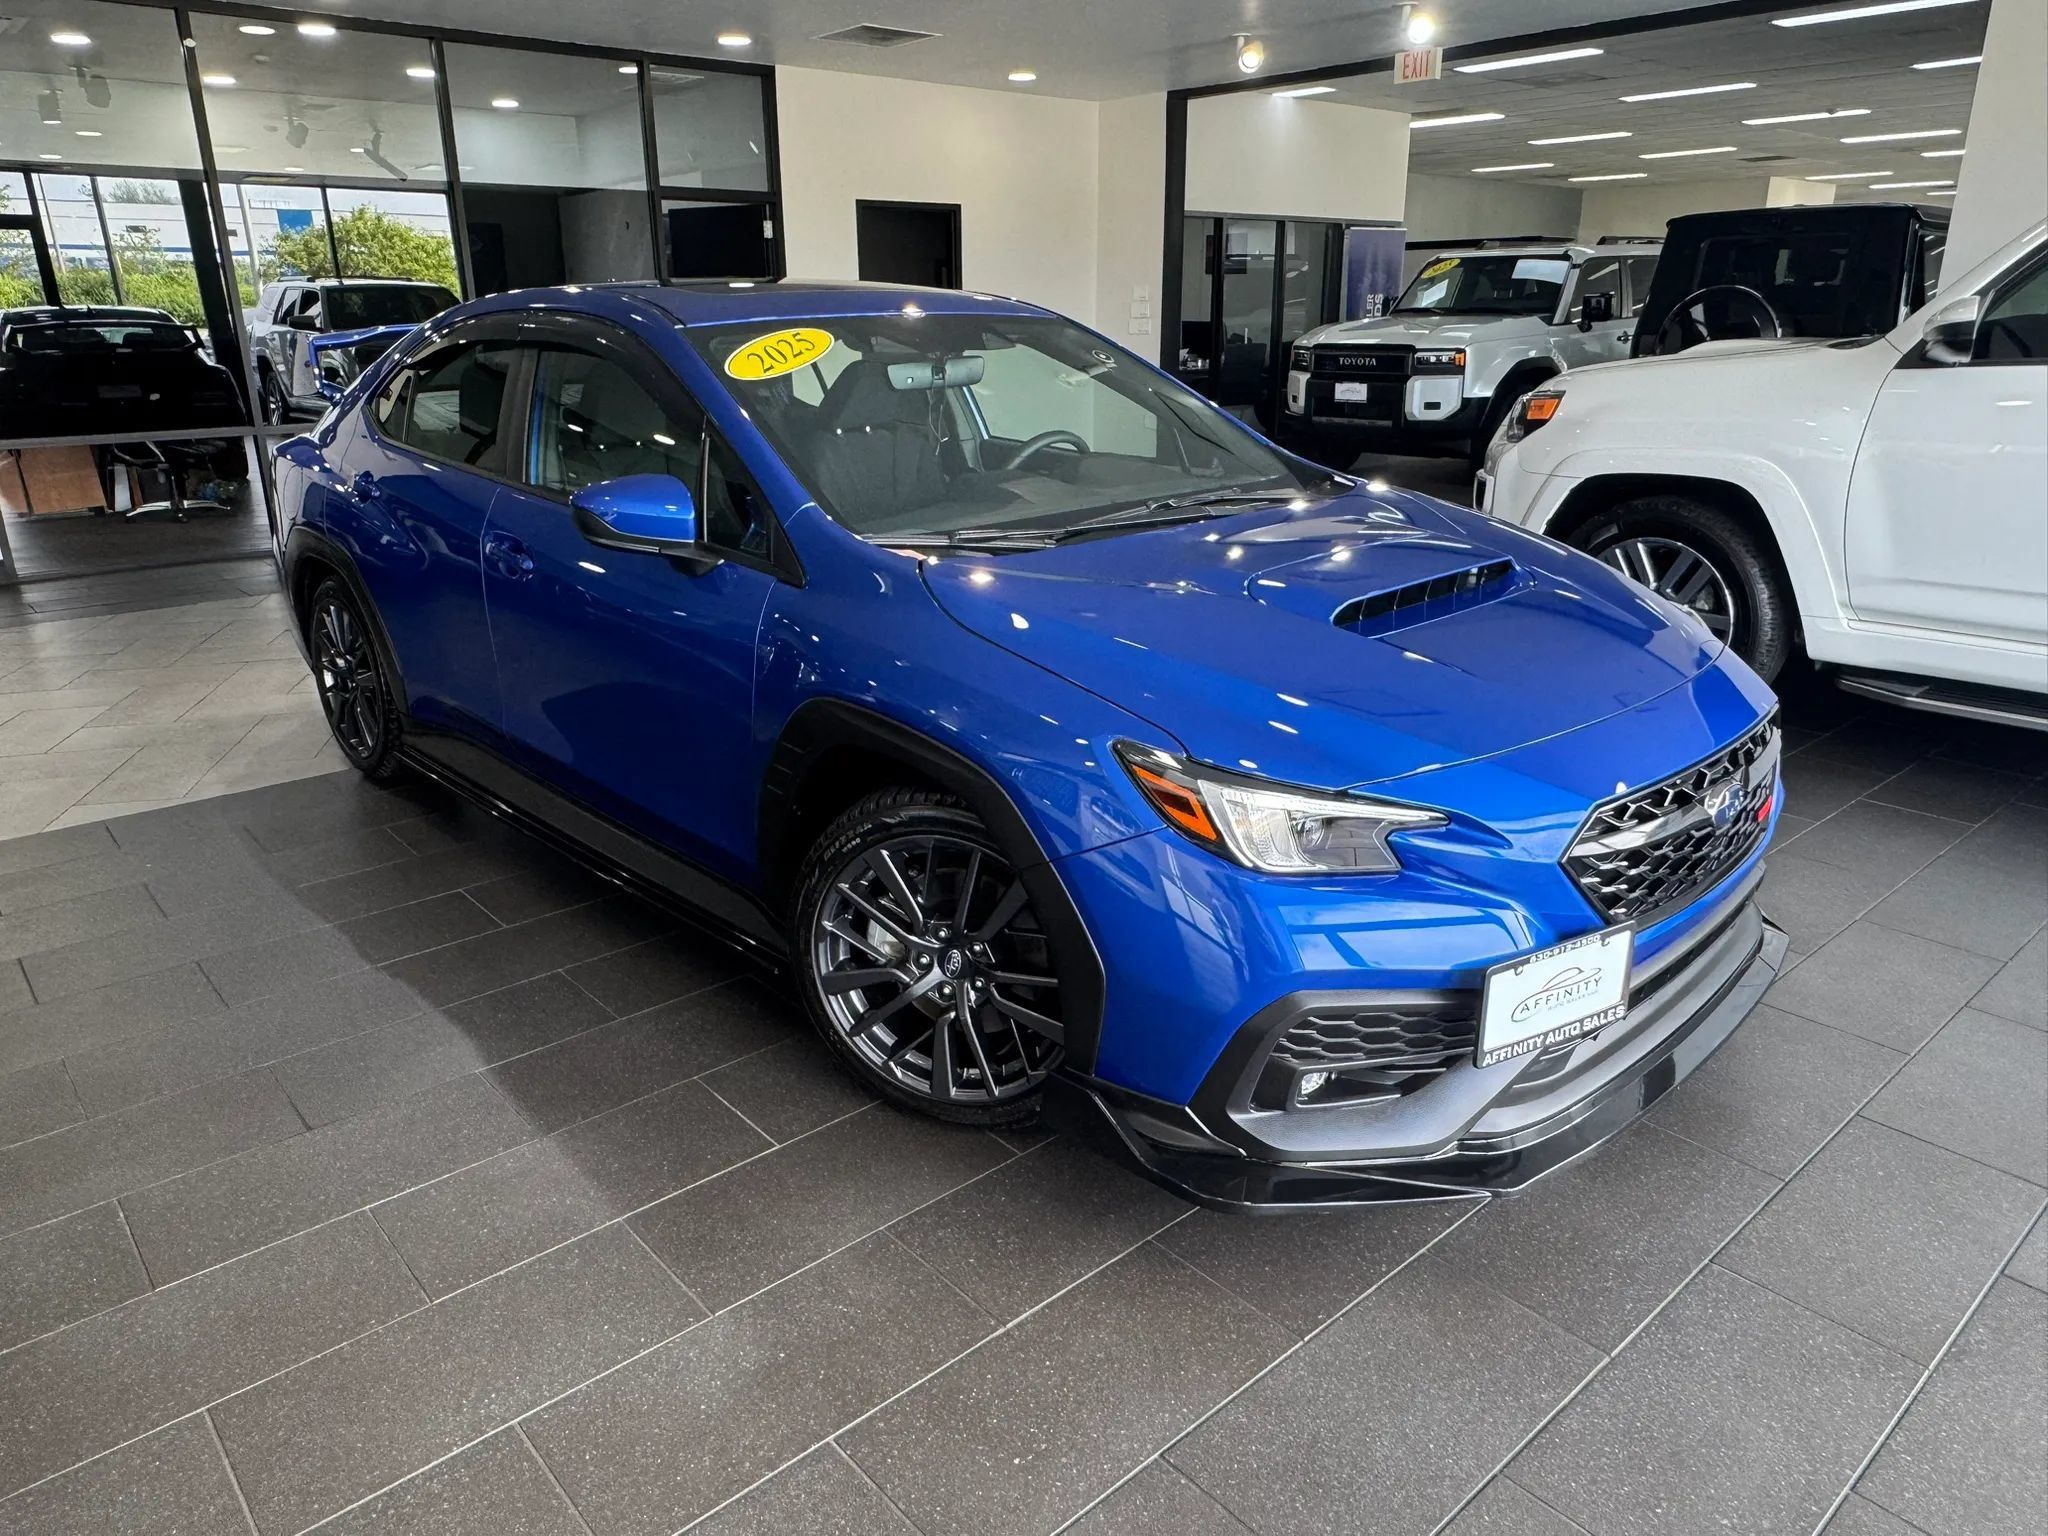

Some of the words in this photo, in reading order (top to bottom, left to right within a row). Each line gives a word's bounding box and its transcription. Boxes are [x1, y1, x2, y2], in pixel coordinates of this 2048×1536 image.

[1402, 50, 1431, 80] EXIT
[746, 332, 815, 374] 2025
[1339, 357, 1377, 367] TOYOTA
[1520, 976, 1602, 1014] AFFINITY
[1482, 1034, 1545, 1067] AFFINITY
[1545, 1022, 1581, 1045] AUTO
[1582, 1005, 1626, 1031] SALES
